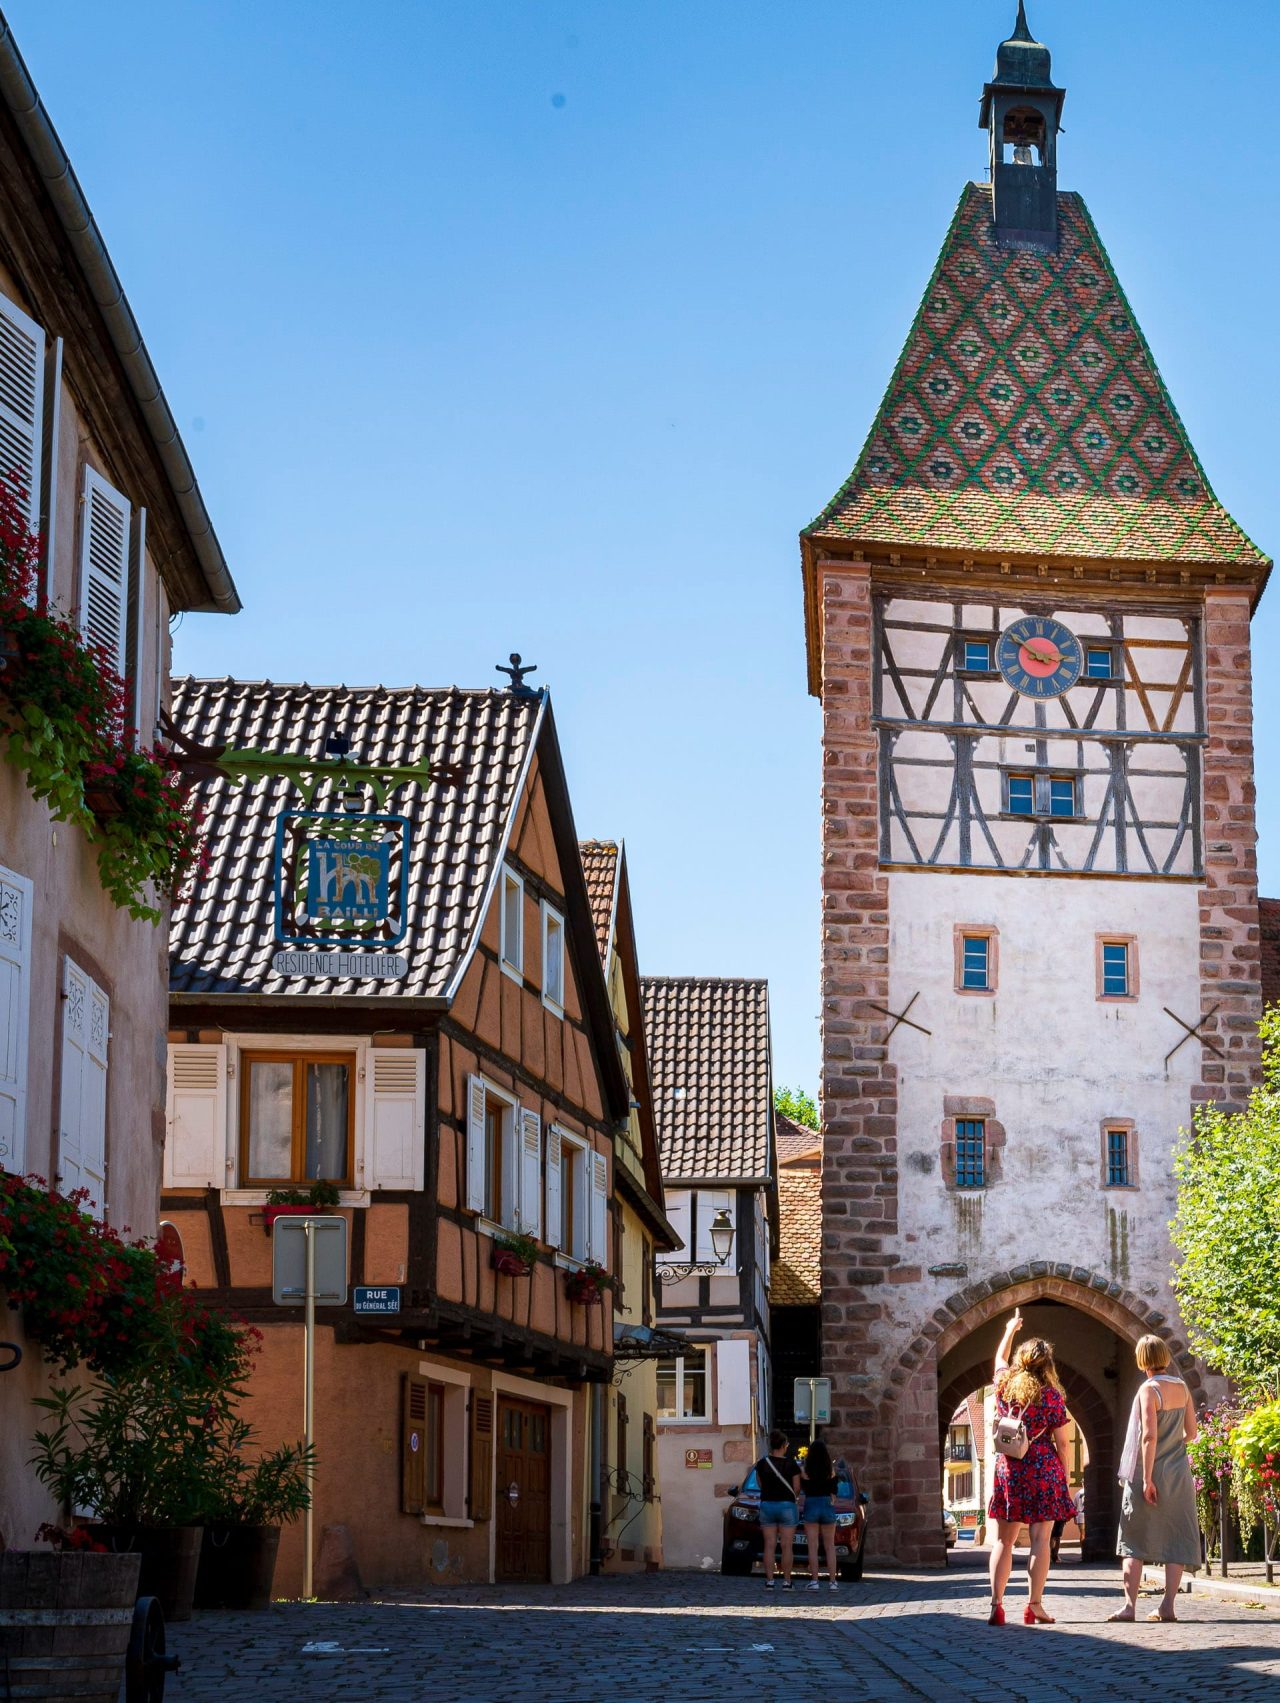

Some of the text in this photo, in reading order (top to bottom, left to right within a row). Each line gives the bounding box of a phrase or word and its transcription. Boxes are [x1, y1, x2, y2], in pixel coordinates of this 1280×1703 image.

[315, 841, 331, 849] LA
[276, 953, 400, 976] RESIDENCE HOTELIERE
[367, 1291, 387, 1299] RUE
